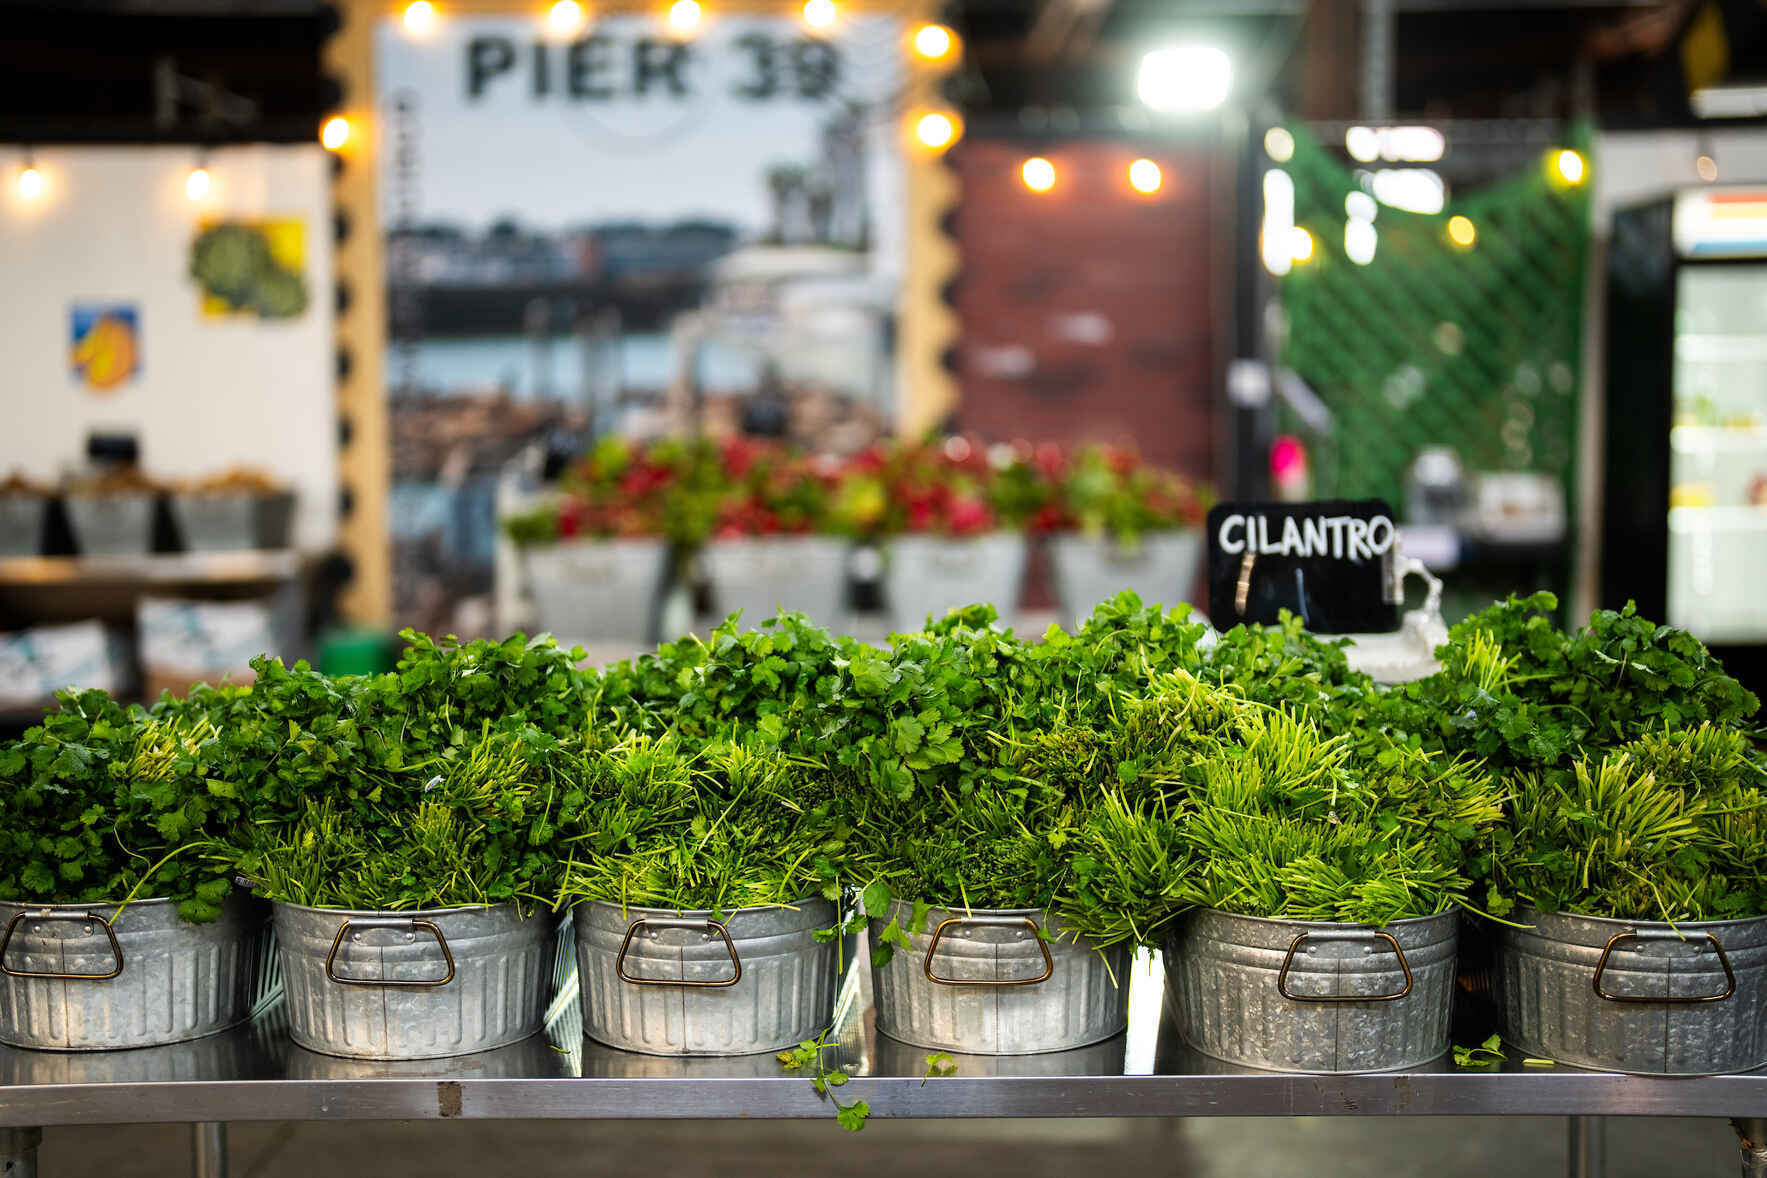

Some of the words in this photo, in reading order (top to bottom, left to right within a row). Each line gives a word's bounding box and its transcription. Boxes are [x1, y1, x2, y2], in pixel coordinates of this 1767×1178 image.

[468, 36, 690, 99] PIER
[732, 37, 842, 99] 39
[1219, 514, 1394, 560] CILANTRO
